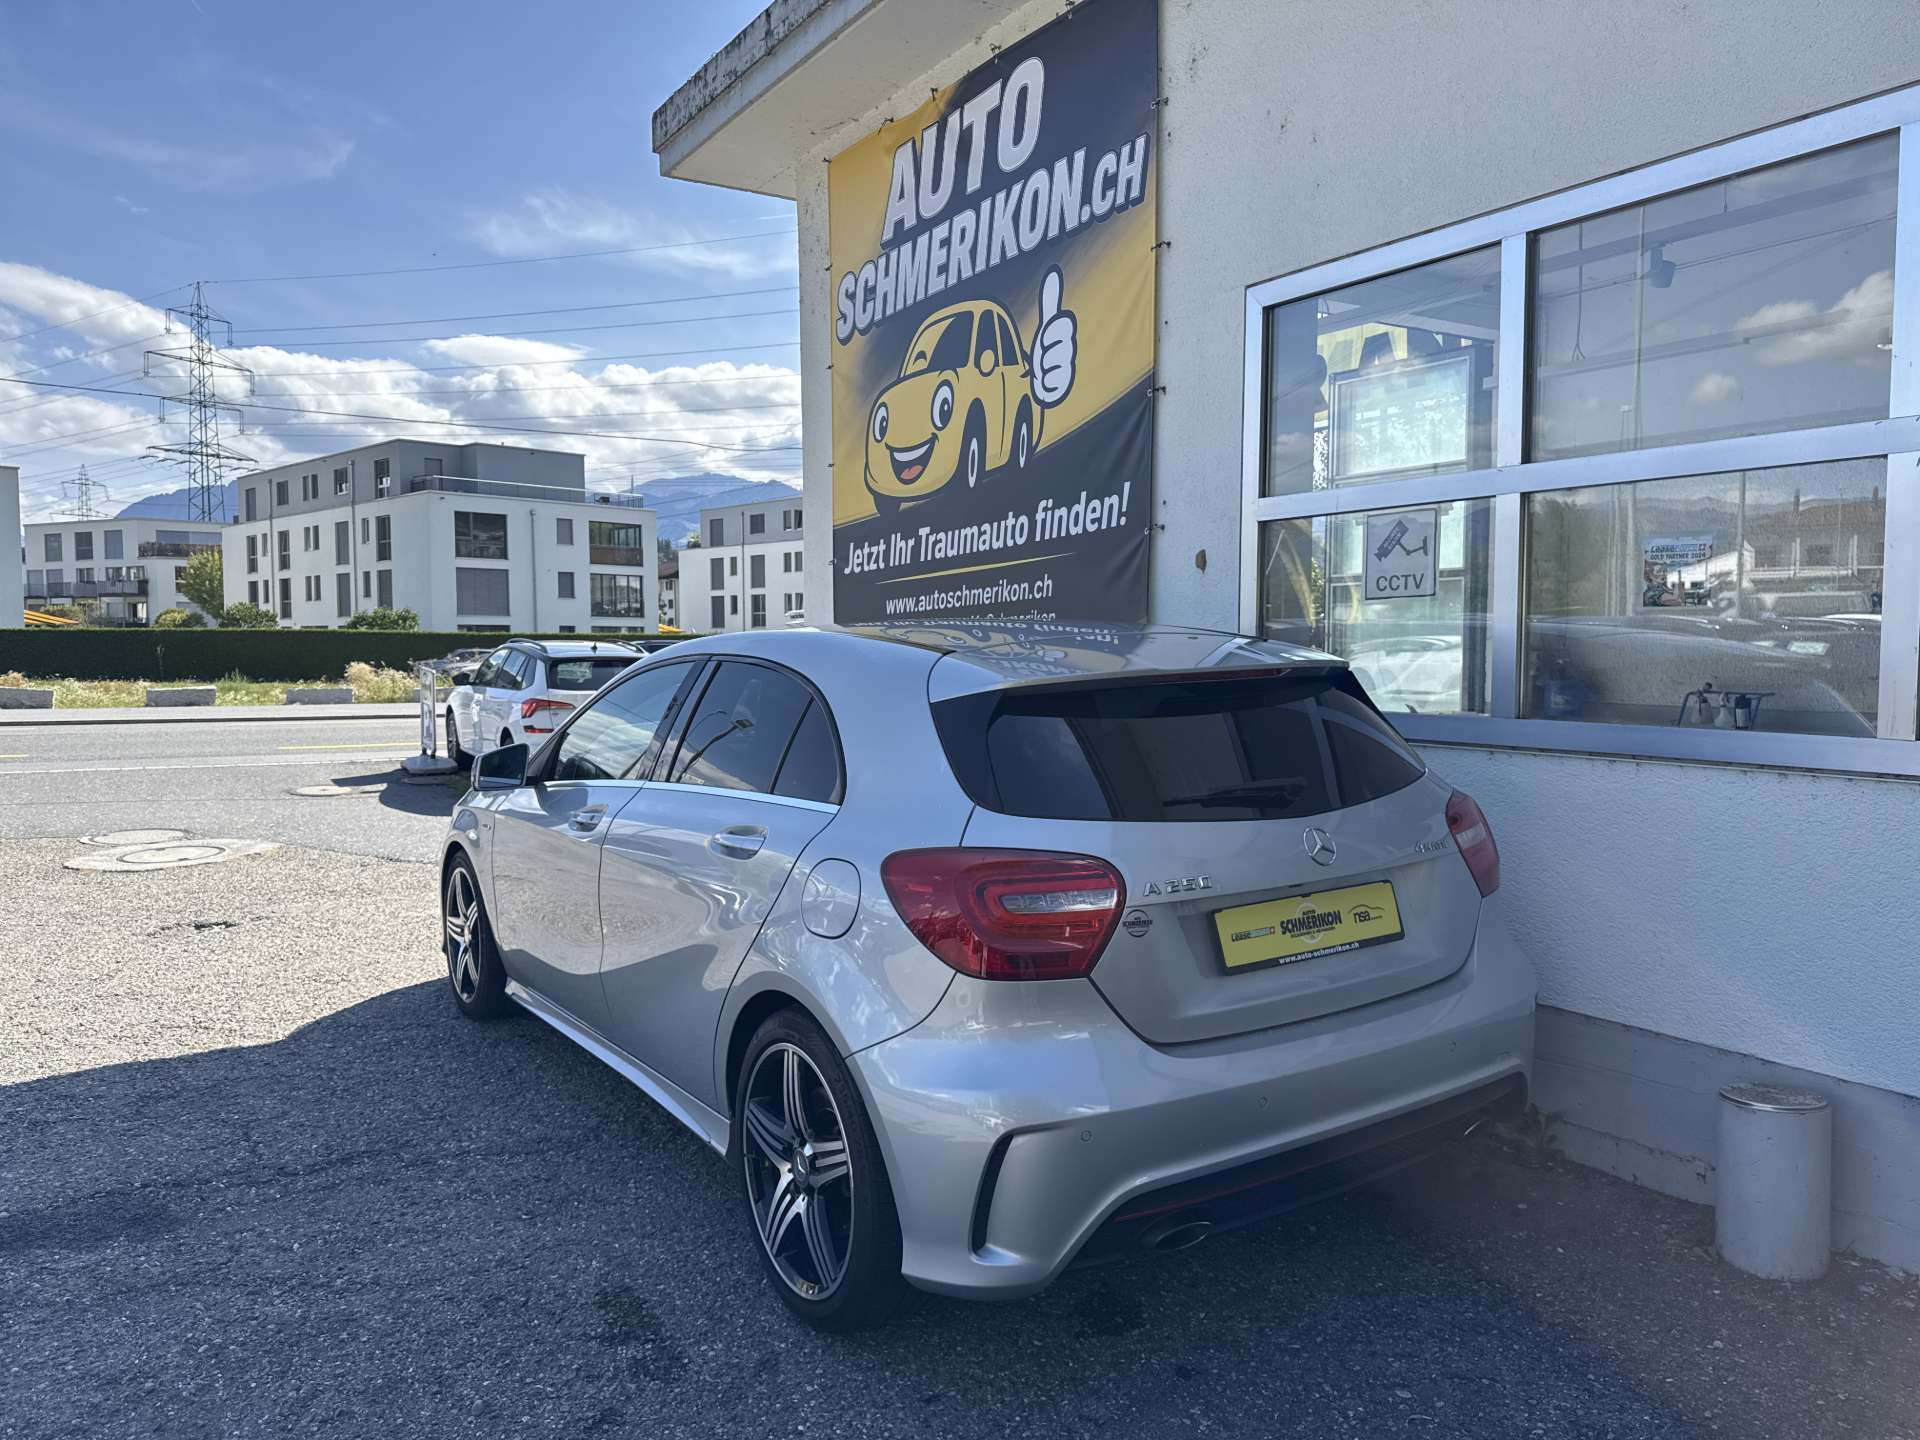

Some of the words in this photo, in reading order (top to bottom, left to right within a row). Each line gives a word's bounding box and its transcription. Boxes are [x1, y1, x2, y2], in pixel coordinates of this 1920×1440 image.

[881, 57, 1044, 245] AUTO
[836, 133, 1149, 341] SCHMERIKON.CH
[844, 538, 886, 575] Jetzt
[889, 533, 915, 567] Ihr
[919, 511, 1028, 562] Traumauto
[1035, 482, 1130, 542] finden!
[886, 573, 1053, 615] www.autoschmerikon.ch
[1376, 572, 1425, 592] CCTV
[1143, 882, 1162, 897] A
[1165, 875, 1212, 894] 250
[1280, 910, 1343, 935] SCHMERIKON
[1353, 910, 1371, 924] nsa
